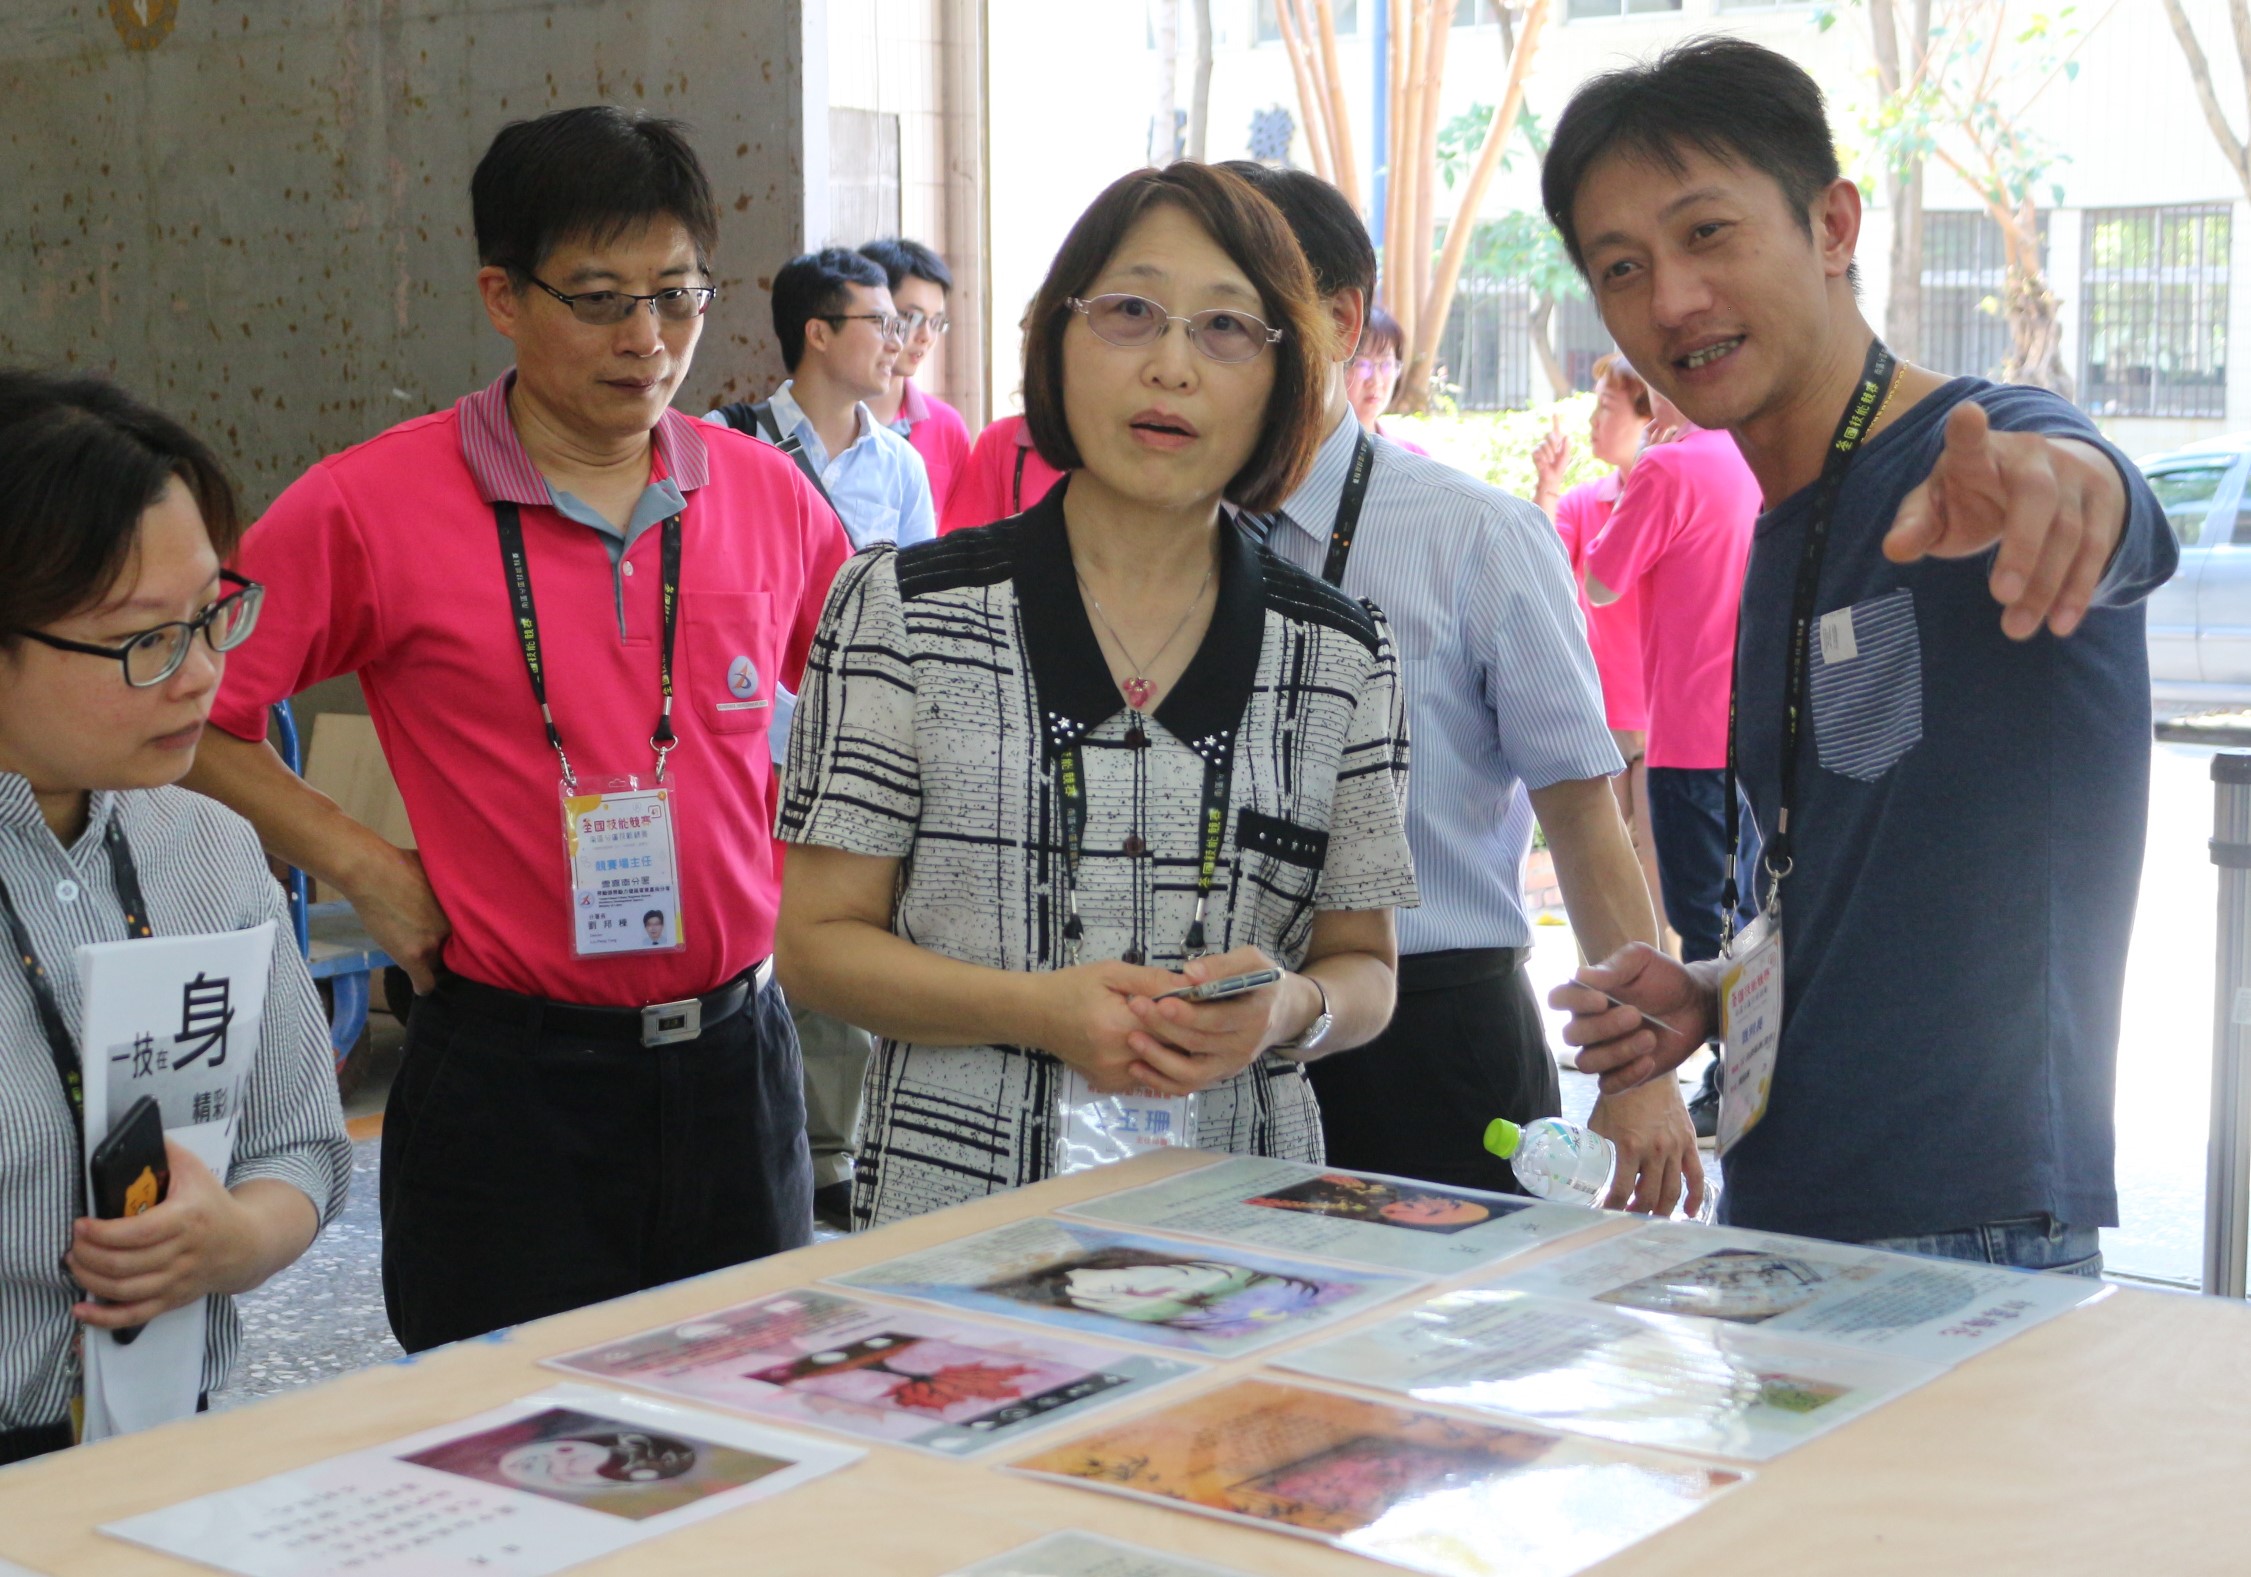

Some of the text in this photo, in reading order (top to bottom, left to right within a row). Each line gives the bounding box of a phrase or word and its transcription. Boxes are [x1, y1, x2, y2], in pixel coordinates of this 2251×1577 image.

[1835, 380, 1880, 452] 全國技能競賽
[1199, 808, 1222, 888] 全國技能競賽
[192, 1087, 228, 1123] 精彩
